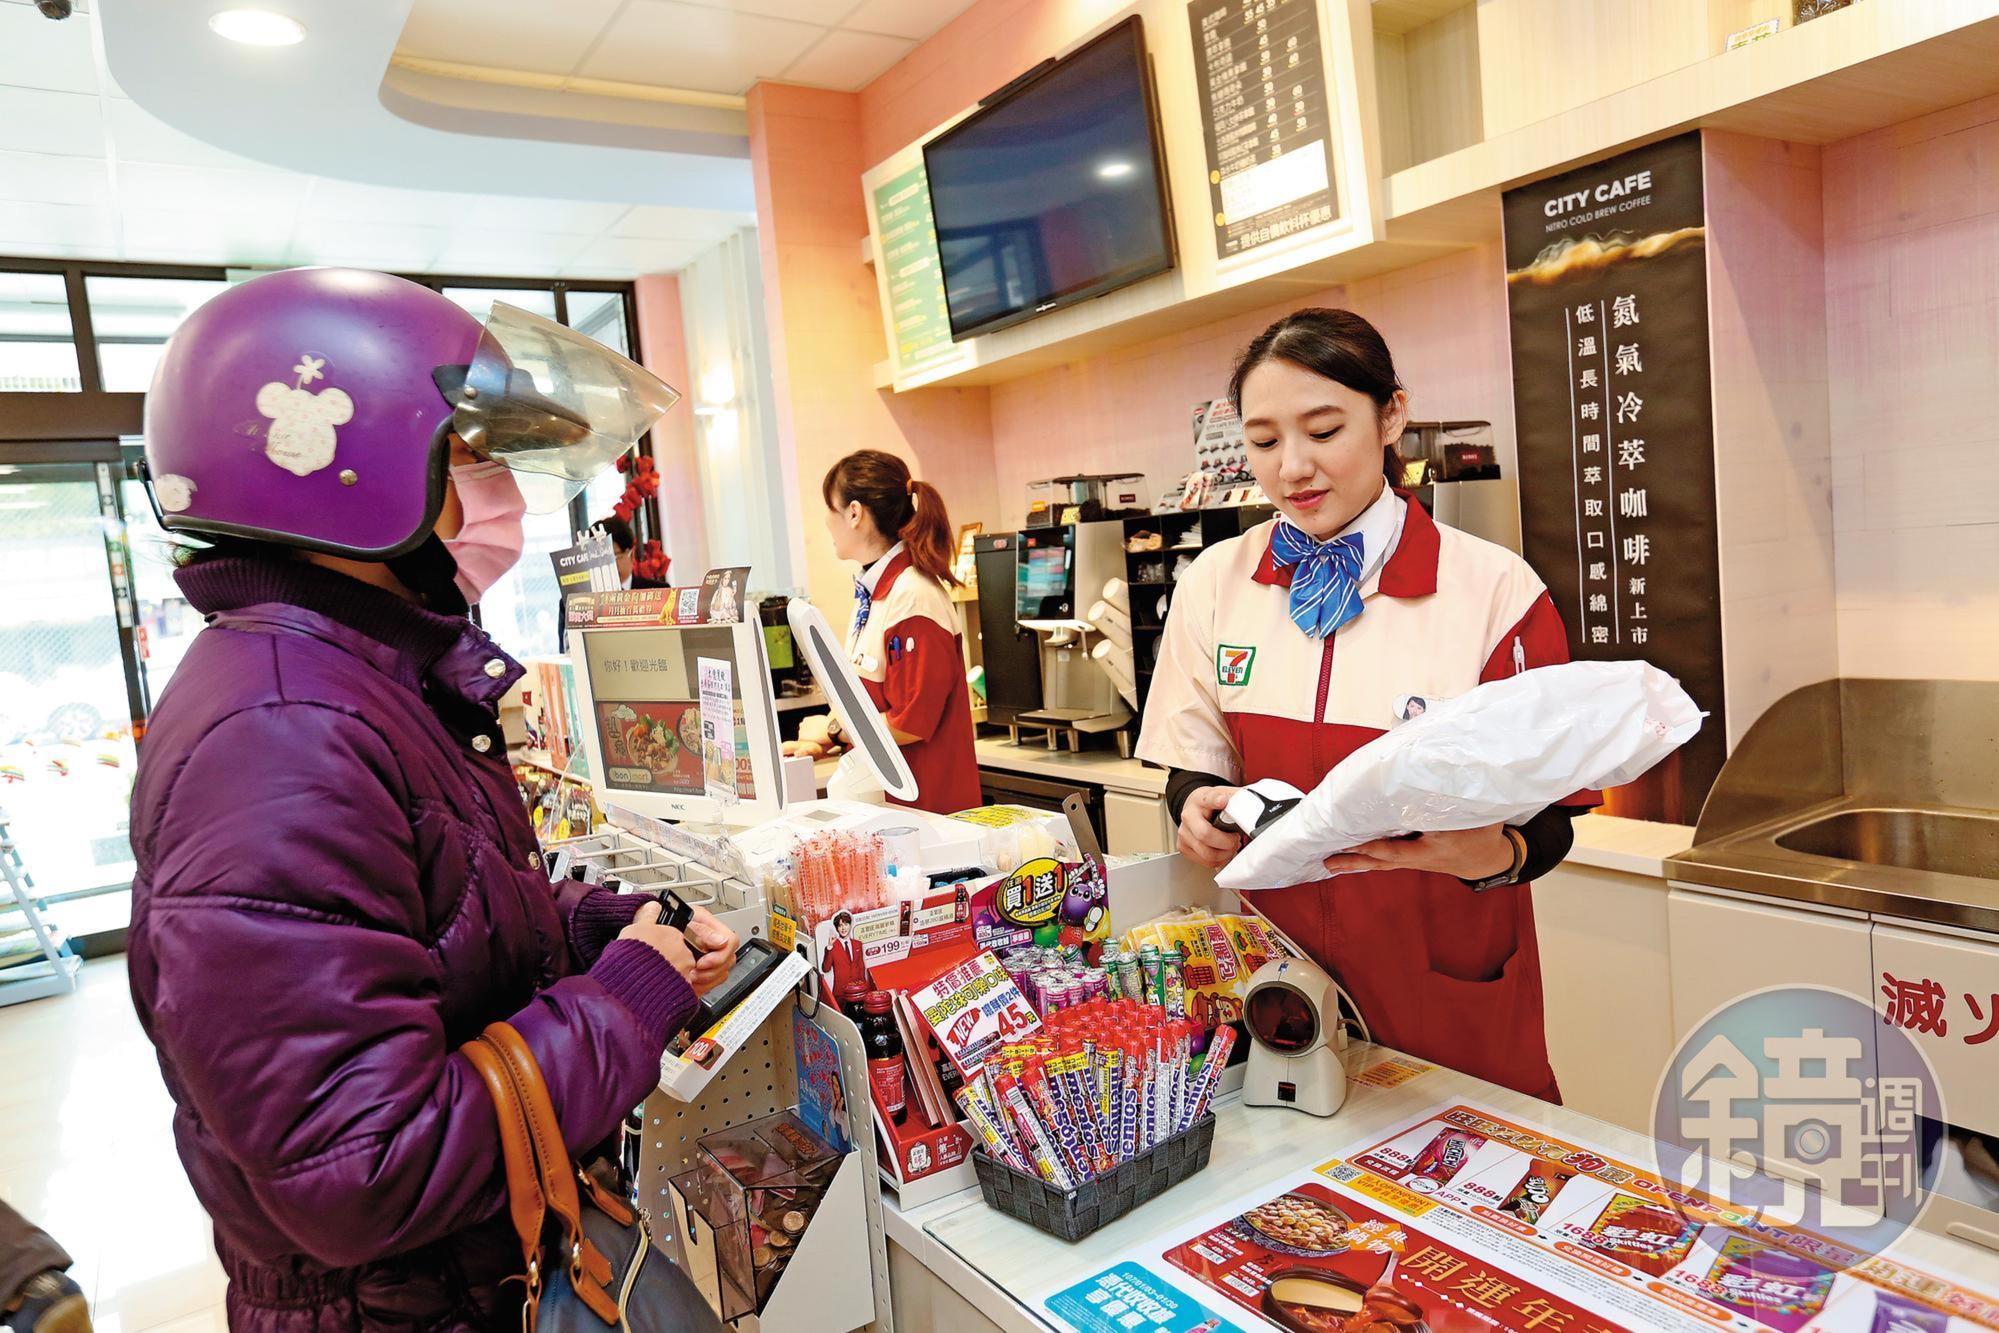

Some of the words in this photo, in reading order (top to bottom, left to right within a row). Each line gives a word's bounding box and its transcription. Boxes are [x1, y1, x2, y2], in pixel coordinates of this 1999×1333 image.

[1544, 189, 1591, 217] CITY
[1594, 170, 1652, 203] CAFE
[1545, 219, 1568, 233] NITRO
[1569, 213, 1594, 227] COLD
[1595, 205, 1618, 220] BREW
[1618, 194, 1651, 212] COFFEE
[1612, 293, 1650, 566] 氮氣冷萃咖啡
[1575, 303, 1609, 645] 低溫長時間萃取口感綿密
[560, 555, 576, 567] CITY
[1629, 577, 1648, 645] 新上市
[671, 803, 687, 811] NEC
[1006, 863, 1066, 912] 買1送1
[881, 940, 900, 953] 199
[1204, 923, 1237, 983] 暖暖包
[923, 965, 1009, 1028] 曼陀珠可樂口味
[932, 959, 984, 999] 特價推薦
[954, 1011, 976, 1042] NEW
[691, 1041, 709, 1056] 100
[1065, 1071, 1099, 1159] mentos
[1435, 1190, 1462, 1204] APP
[1462, 1182, 1504, 1201] 888點
[1359, 1218, 1408, 1245] 經典
[1084, 1288, 1147, 1329] 享優惠
[1399, 1245, 1628, 1333] 開運年
